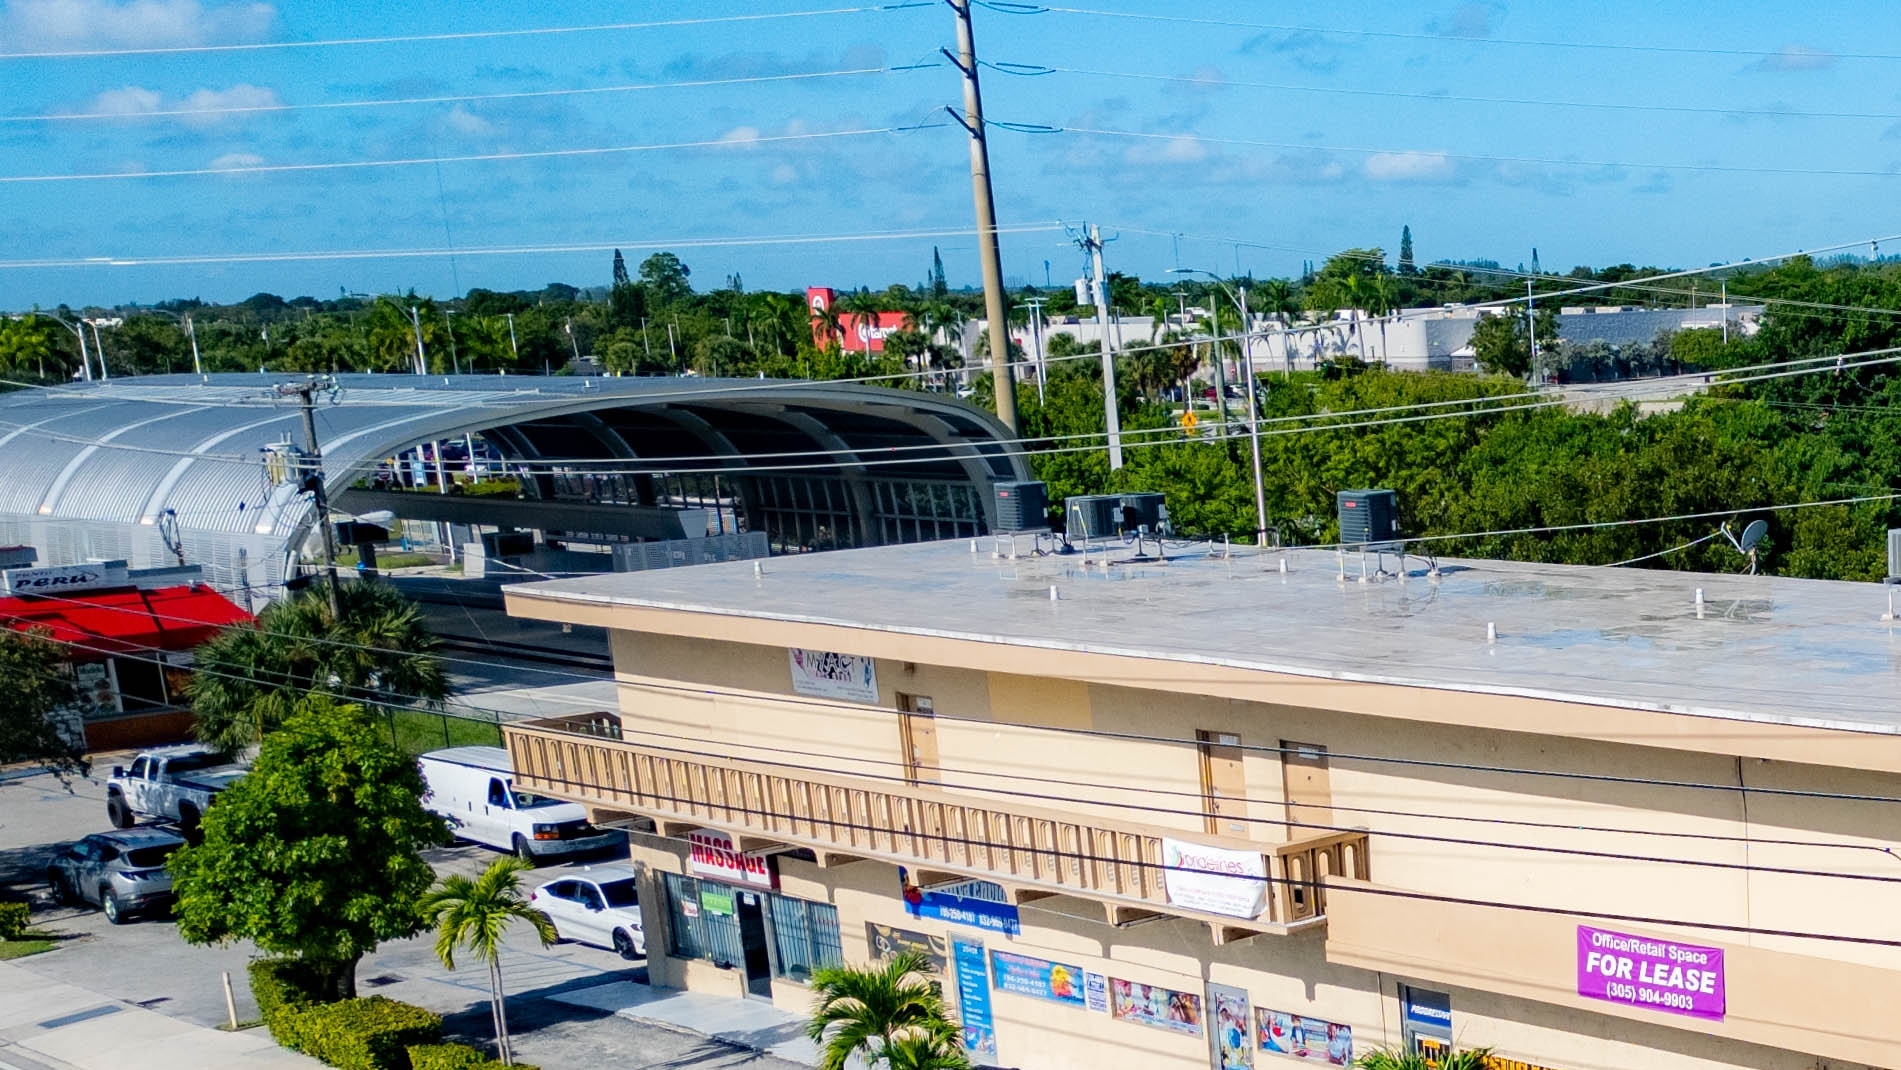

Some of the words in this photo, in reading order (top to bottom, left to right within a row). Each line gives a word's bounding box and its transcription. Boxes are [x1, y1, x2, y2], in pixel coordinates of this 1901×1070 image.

[1592, 932, 1666, 958] Office/Retail
[1668, 945, 1708, 965] Space
[1586, 951, 1633, 980] FOR
[1639, 961, 1717, 995] LEASE
[1606, 981, 1637, 1003] (305)
[1639, 989, 1694, 1010] 904-9903
